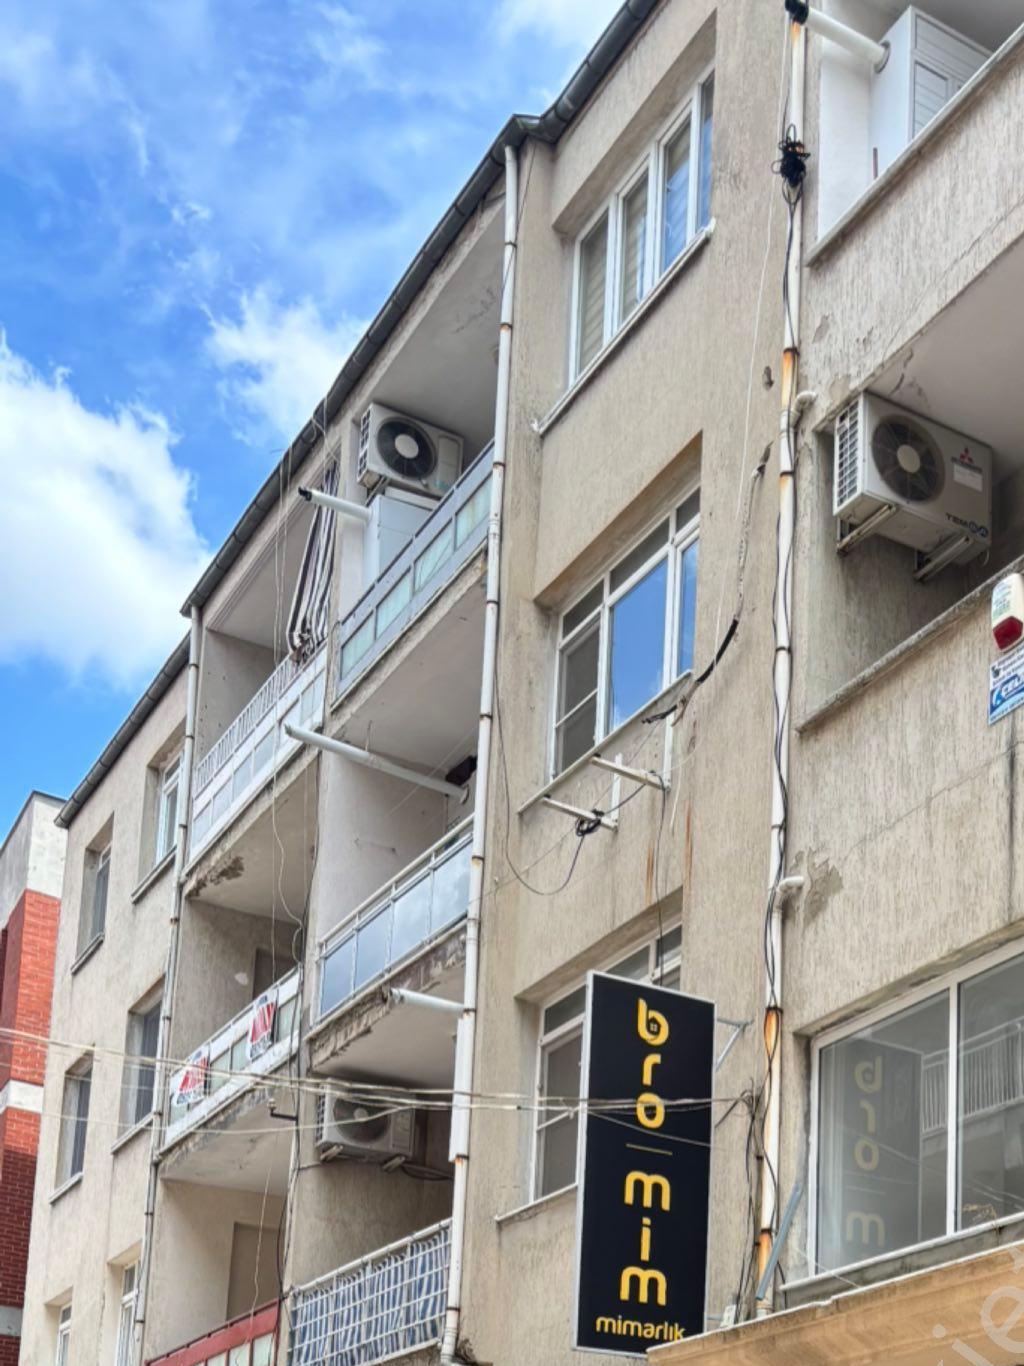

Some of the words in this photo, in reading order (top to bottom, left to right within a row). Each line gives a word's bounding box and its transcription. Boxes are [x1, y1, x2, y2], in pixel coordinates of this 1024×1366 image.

[636, 998, 670, 1129] bro
[619, 1170, 671, 1308] mim
[595, 1314, 686, 1342] mimarlık
